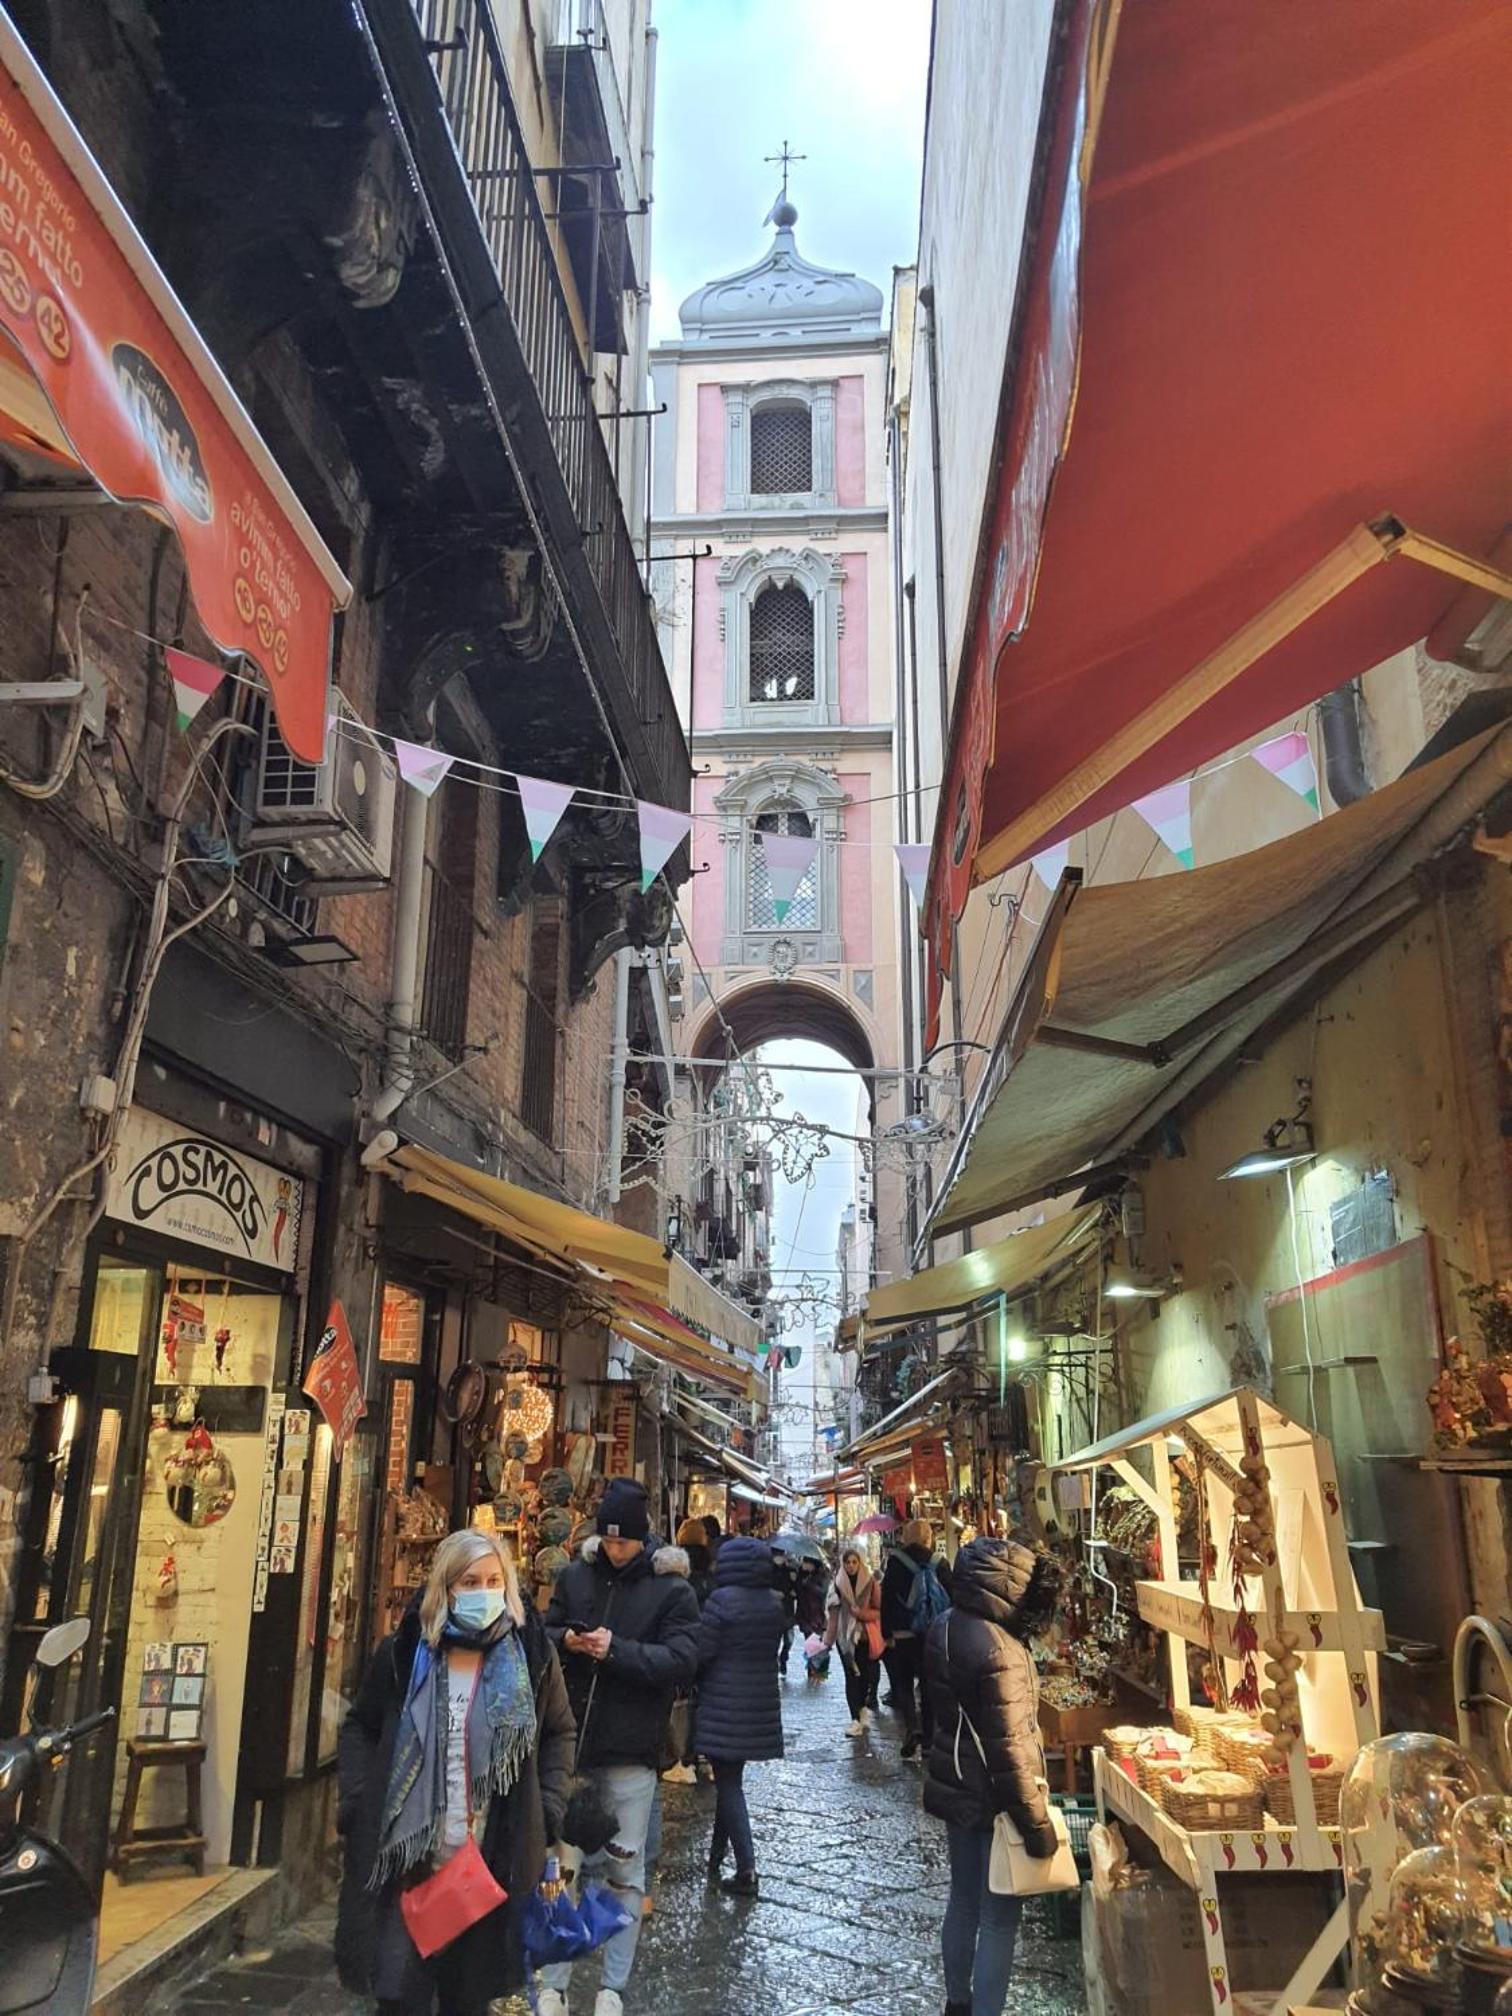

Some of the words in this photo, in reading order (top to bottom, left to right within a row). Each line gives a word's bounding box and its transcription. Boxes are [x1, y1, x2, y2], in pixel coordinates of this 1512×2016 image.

[0, 102, 18, 148] an
[18, 139, 75, 231] Gregorio
[35, 202, 82, 289] fatto
[41, 305, 66, 353] 42
[131, 1145, 259, 1240] COSMOS
